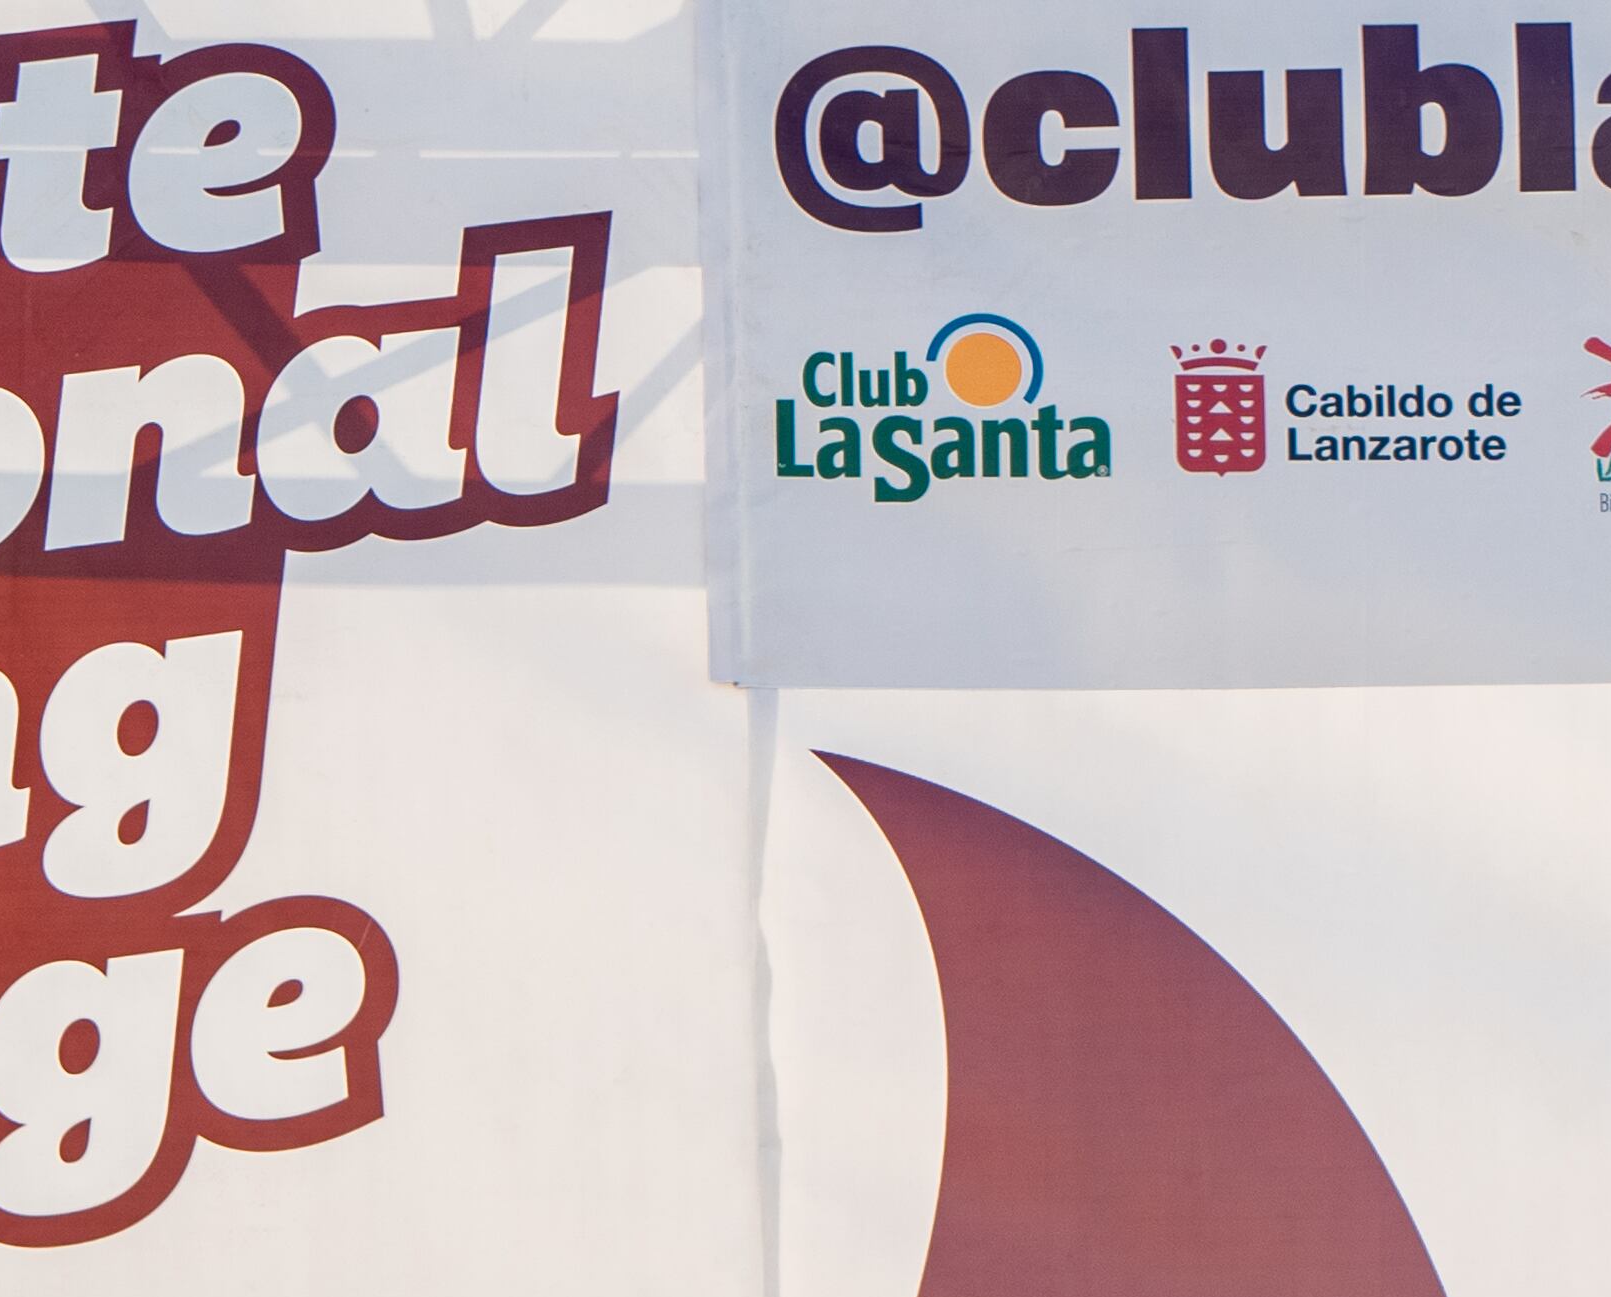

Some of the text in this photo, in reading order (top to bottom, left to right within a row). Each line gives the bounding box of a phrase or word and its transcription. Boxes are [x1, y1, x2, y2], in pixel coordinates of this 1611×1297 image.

[802, 352, 930, 408] Club
[1285, 384, 1522, 417] Cabildo de
[775, 399, 1112, 503] LaSanta
[1287, 428, 1507, 461] Lanzarote
